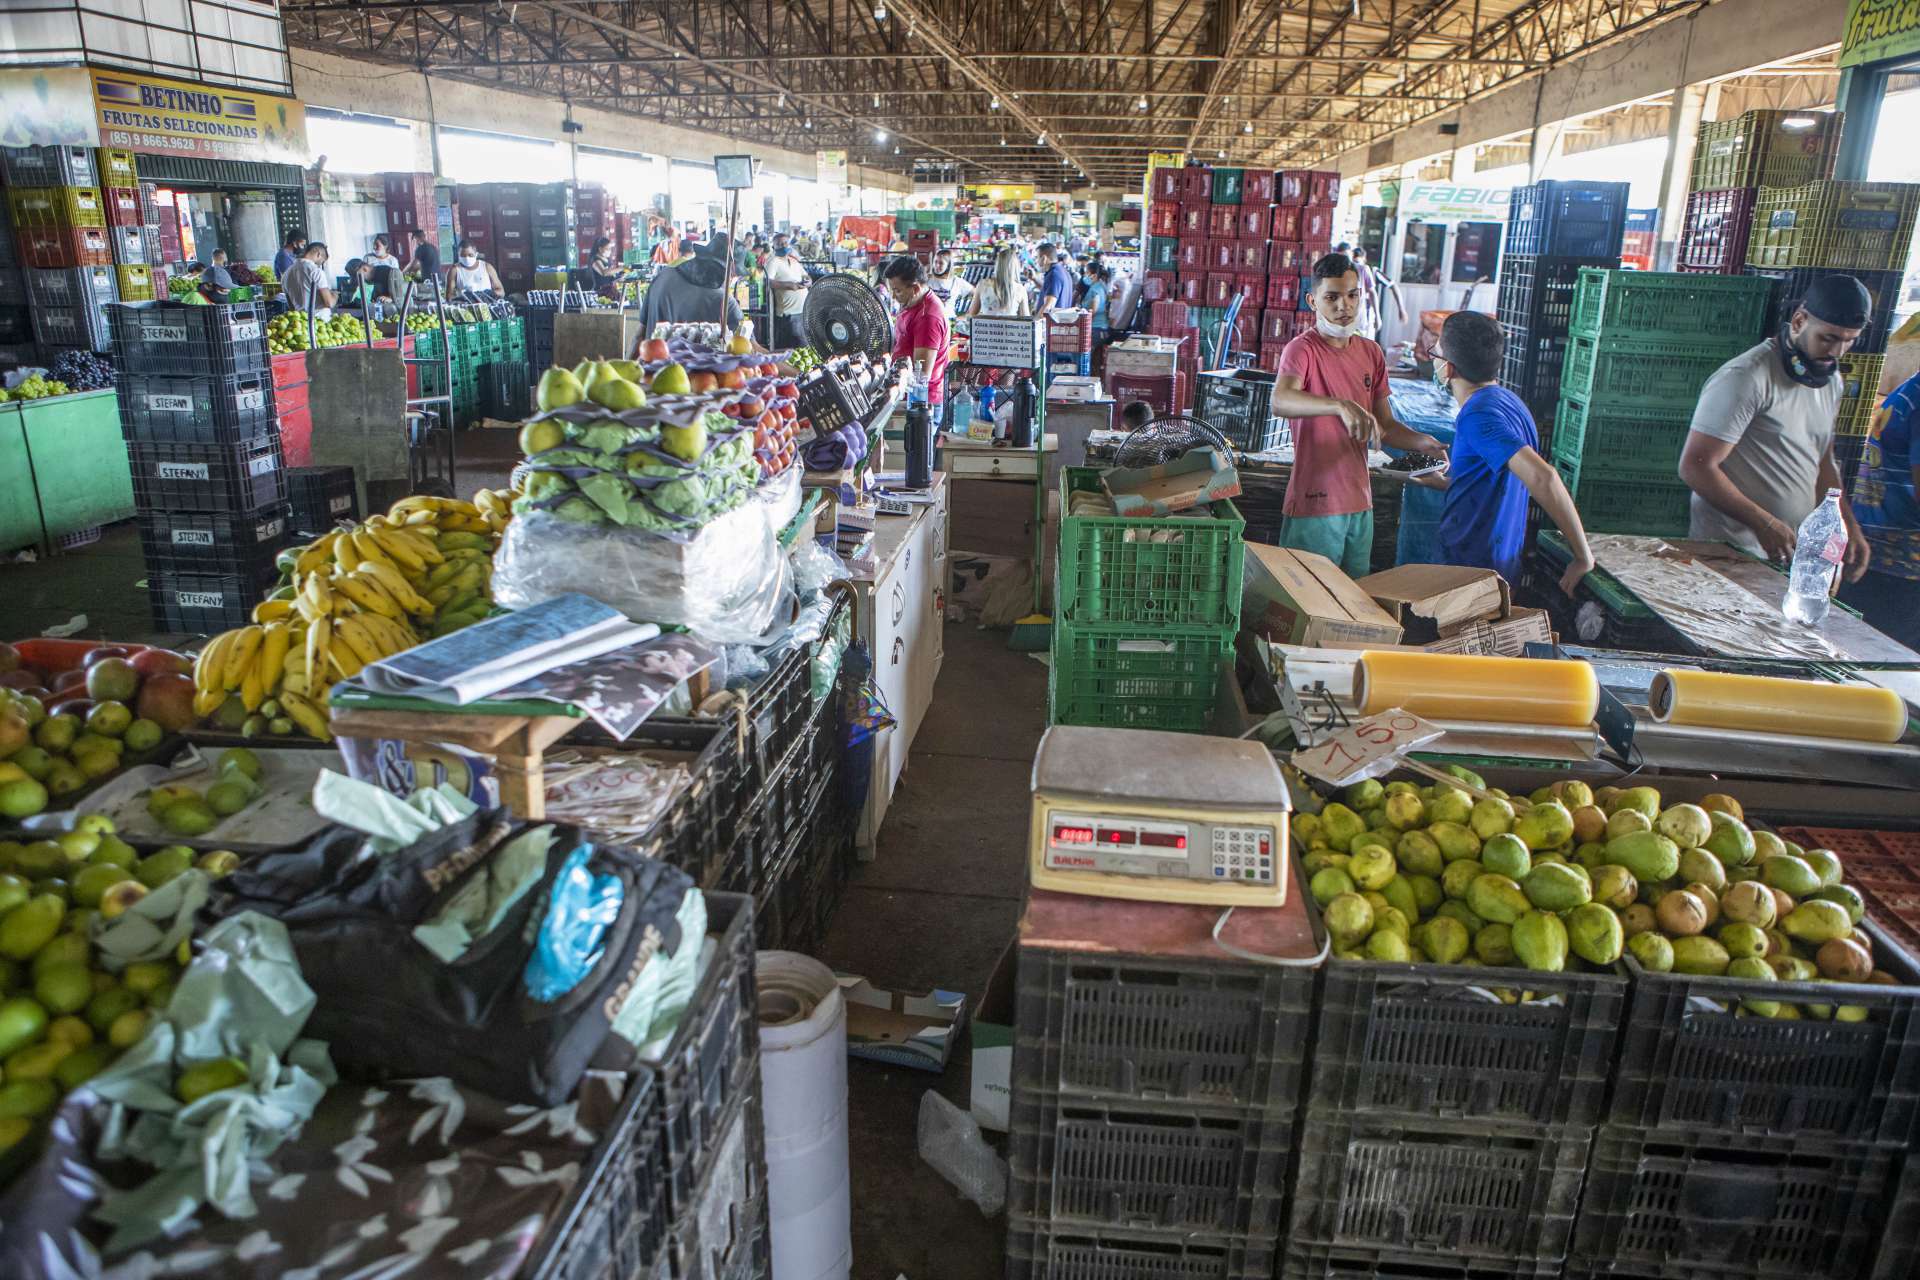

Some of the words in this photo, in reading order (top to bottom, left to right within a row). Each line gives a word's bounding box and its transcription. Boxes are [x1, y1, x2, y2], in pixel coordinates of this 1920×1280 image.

[139, 85, 223, 117] BETINHO
[103, 110, 161, 130] FRUTAS
[163, 116, 258, 139] SELECIONADAS
[110, 131, 132, 147] (85)
[134, 135, 140, 147] 9
[141, 326, 185, 339] STEFANY
[162, 467, 205, 479] STEFANY
[181, 593, 223, 605] STEFANY
